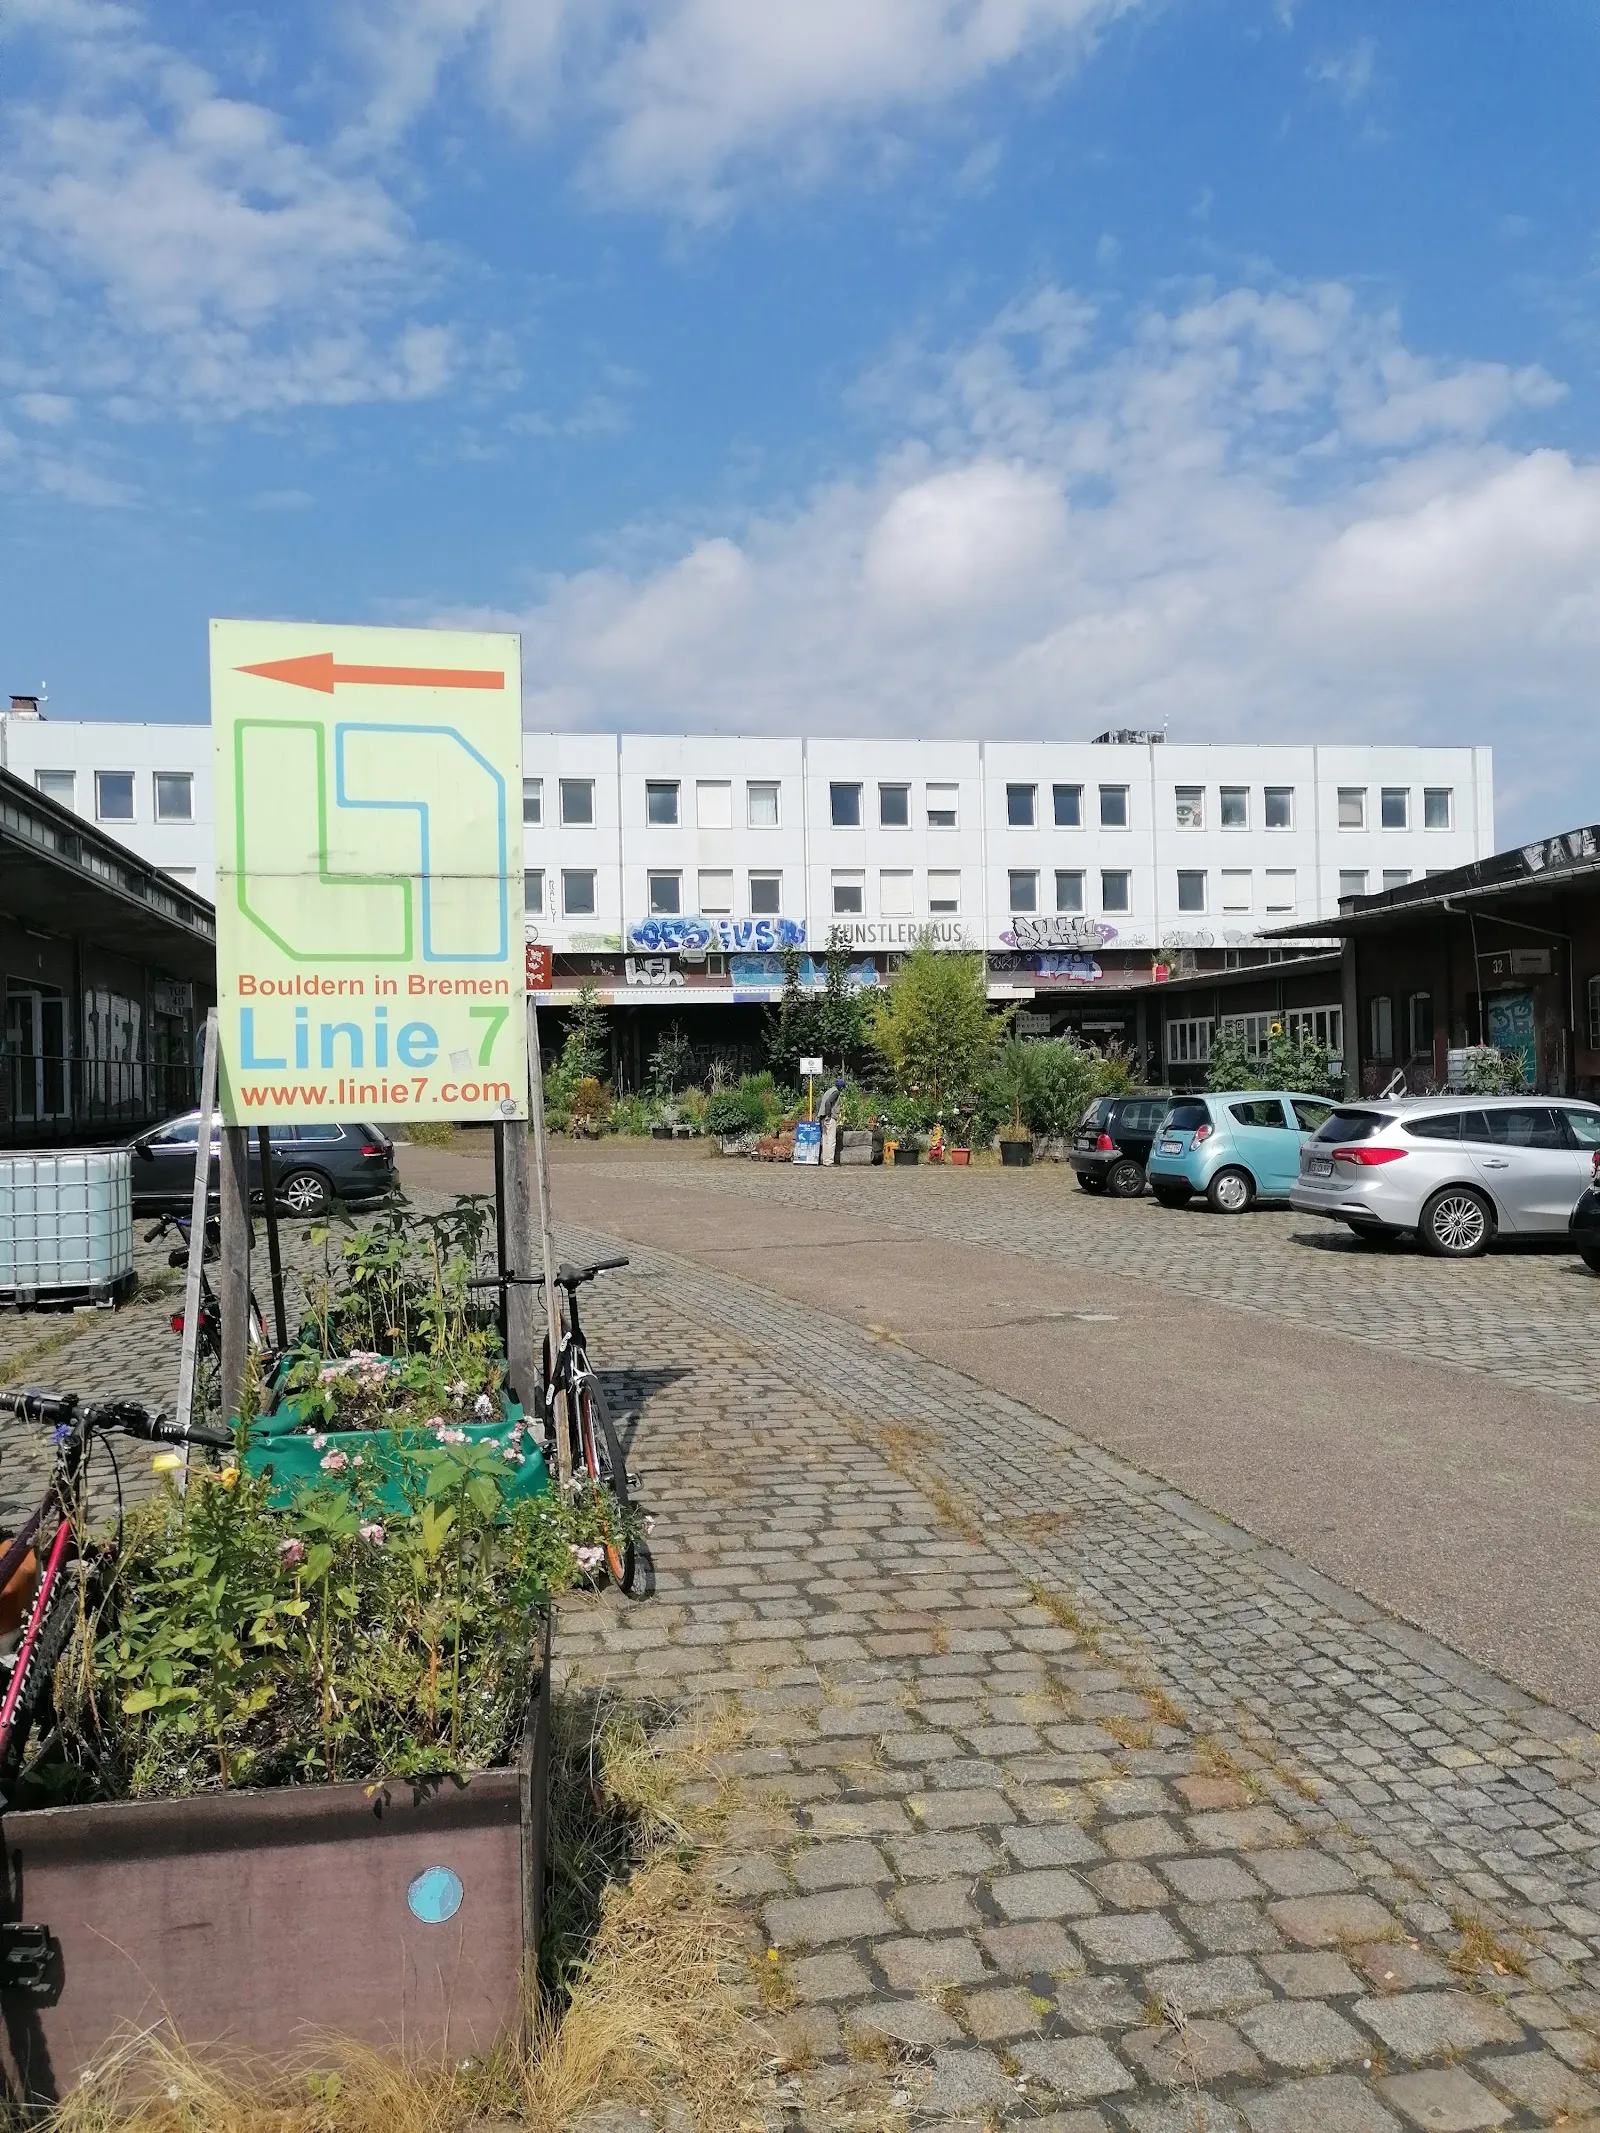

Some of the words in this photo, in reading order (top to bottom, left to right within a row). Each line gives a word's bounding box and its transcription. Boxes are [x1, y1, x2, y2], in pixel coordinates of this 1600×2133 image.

[831, 922, 963, 943] KÜNSTLERHAUS
[1492, 959, 1504, 974] 32
[238, 974, 364, 995] Bouldern
[374, 975, 397, 994] in
[408, 975, 509, 995] Bremen
[240, 1006, 439, 1070] Linie
[469, 1005, 510, 1067] 7
[241, 1077, 511, 1106] www.linie7.com
